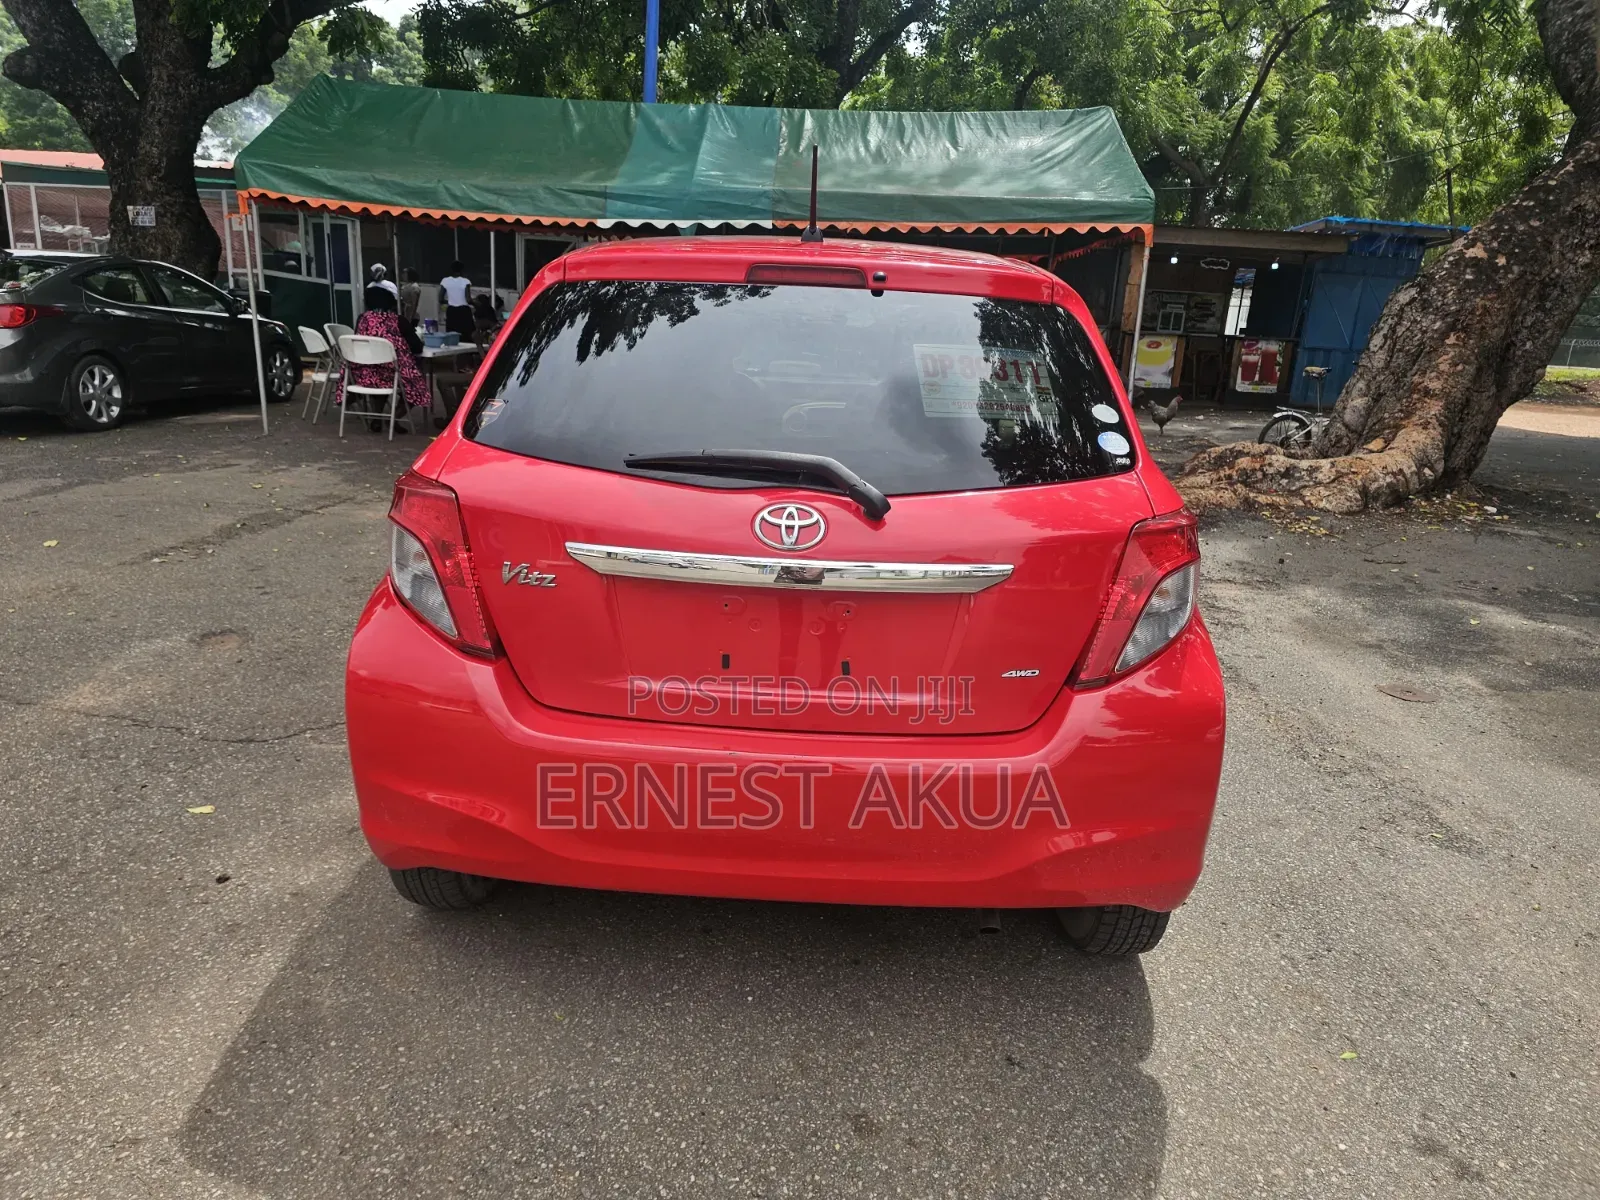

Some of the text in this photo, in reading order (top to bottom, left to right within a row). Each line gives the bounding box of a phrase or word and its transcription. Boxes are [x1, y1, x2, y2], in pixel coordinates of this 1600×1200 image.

[920, 354, 954, 379] DP
[502, 561, 558, 587] Vitz
[1001, 669, 1040, 678] 4WD
